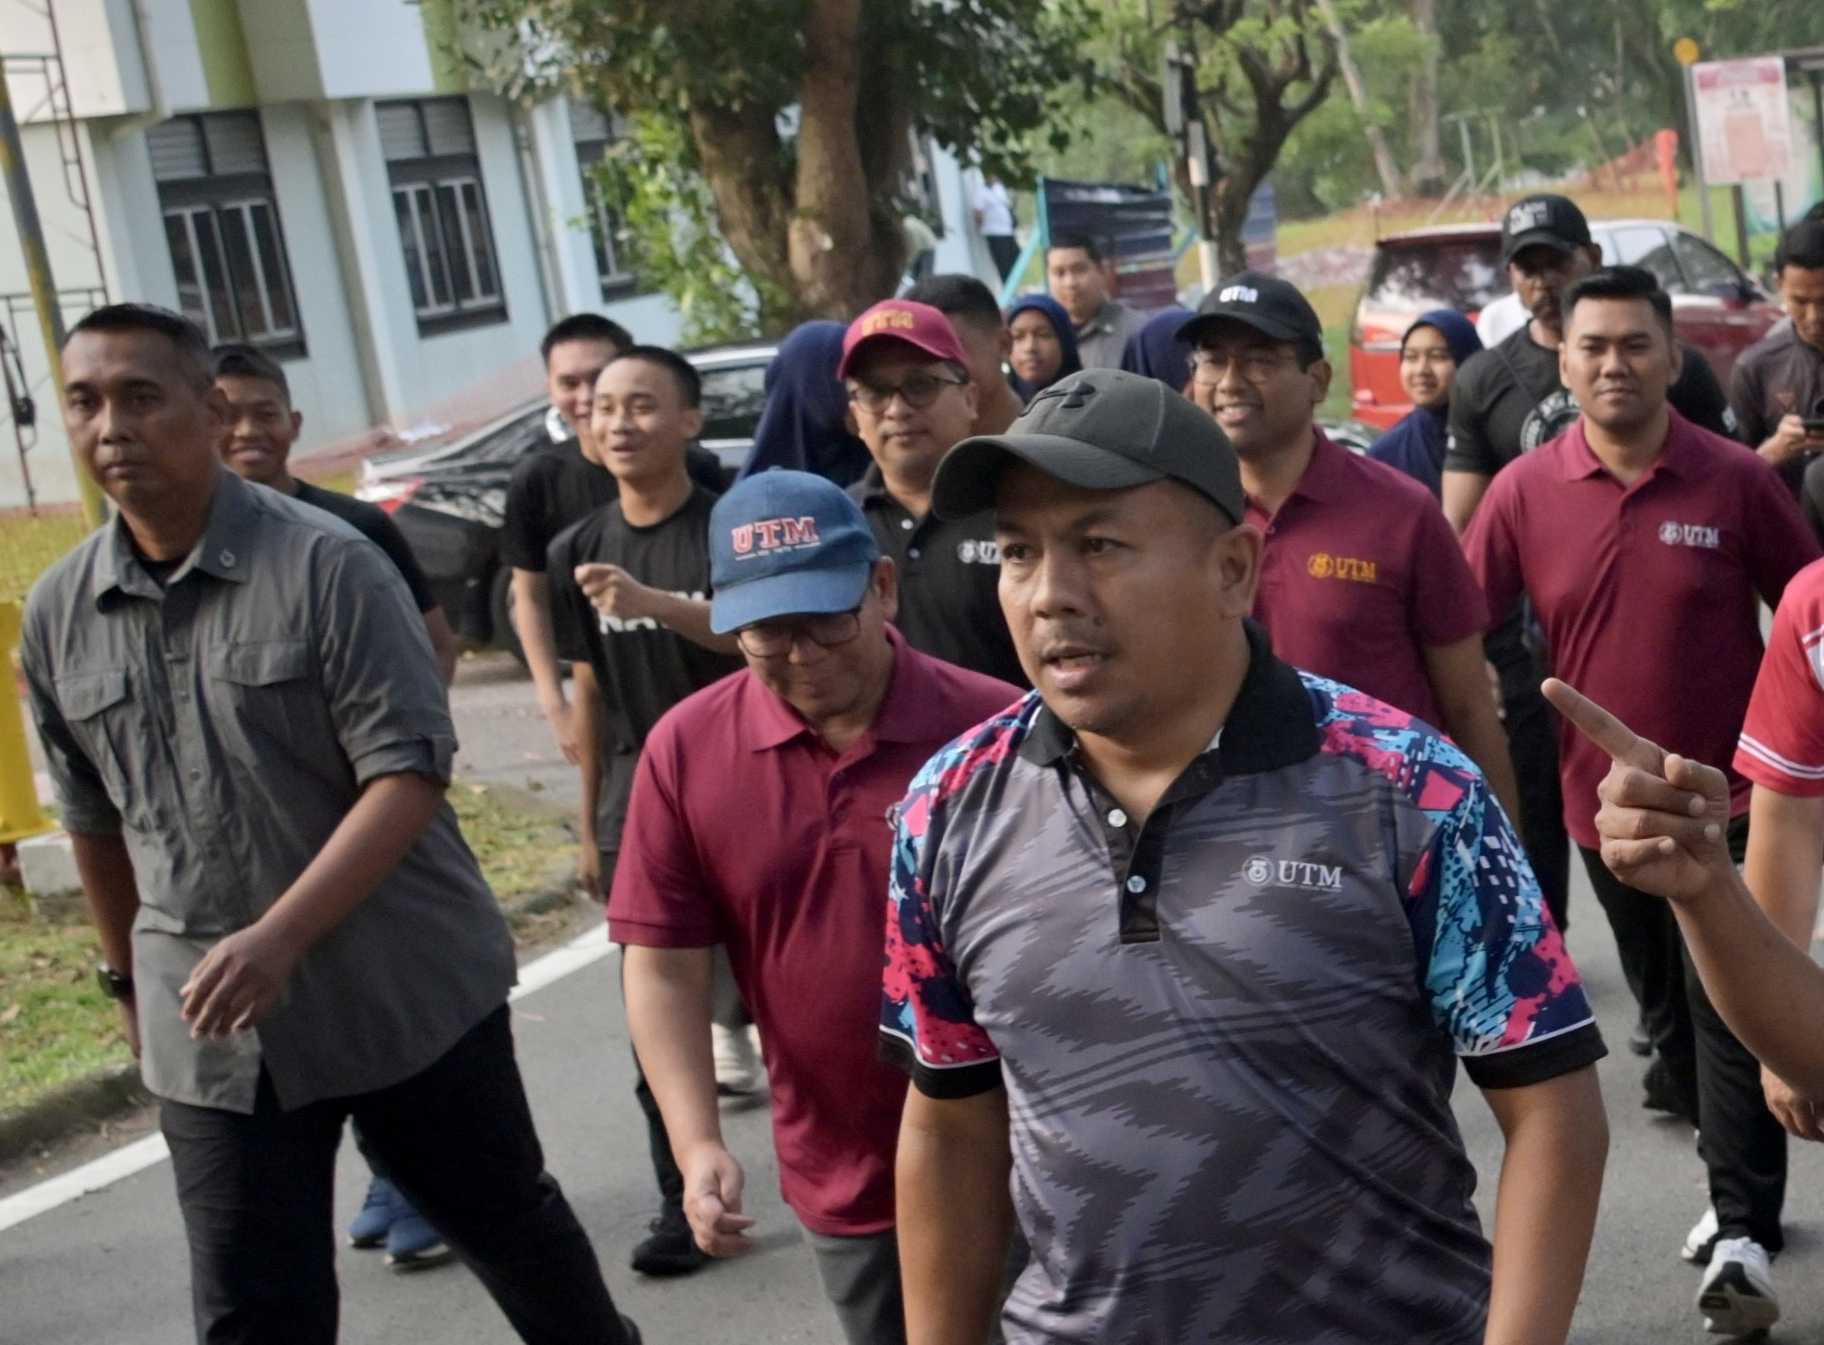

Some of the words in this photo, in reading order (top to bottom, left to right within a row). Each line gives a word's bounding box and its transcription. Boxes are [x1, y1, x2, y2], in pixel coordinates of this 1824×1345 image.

[731, 516, 820, 553] UTM
[1684, 524, 1719, 546] UTM
[1336, 557, 1376, 581] UTM
[1278, 861, 1343, 888] UTM
